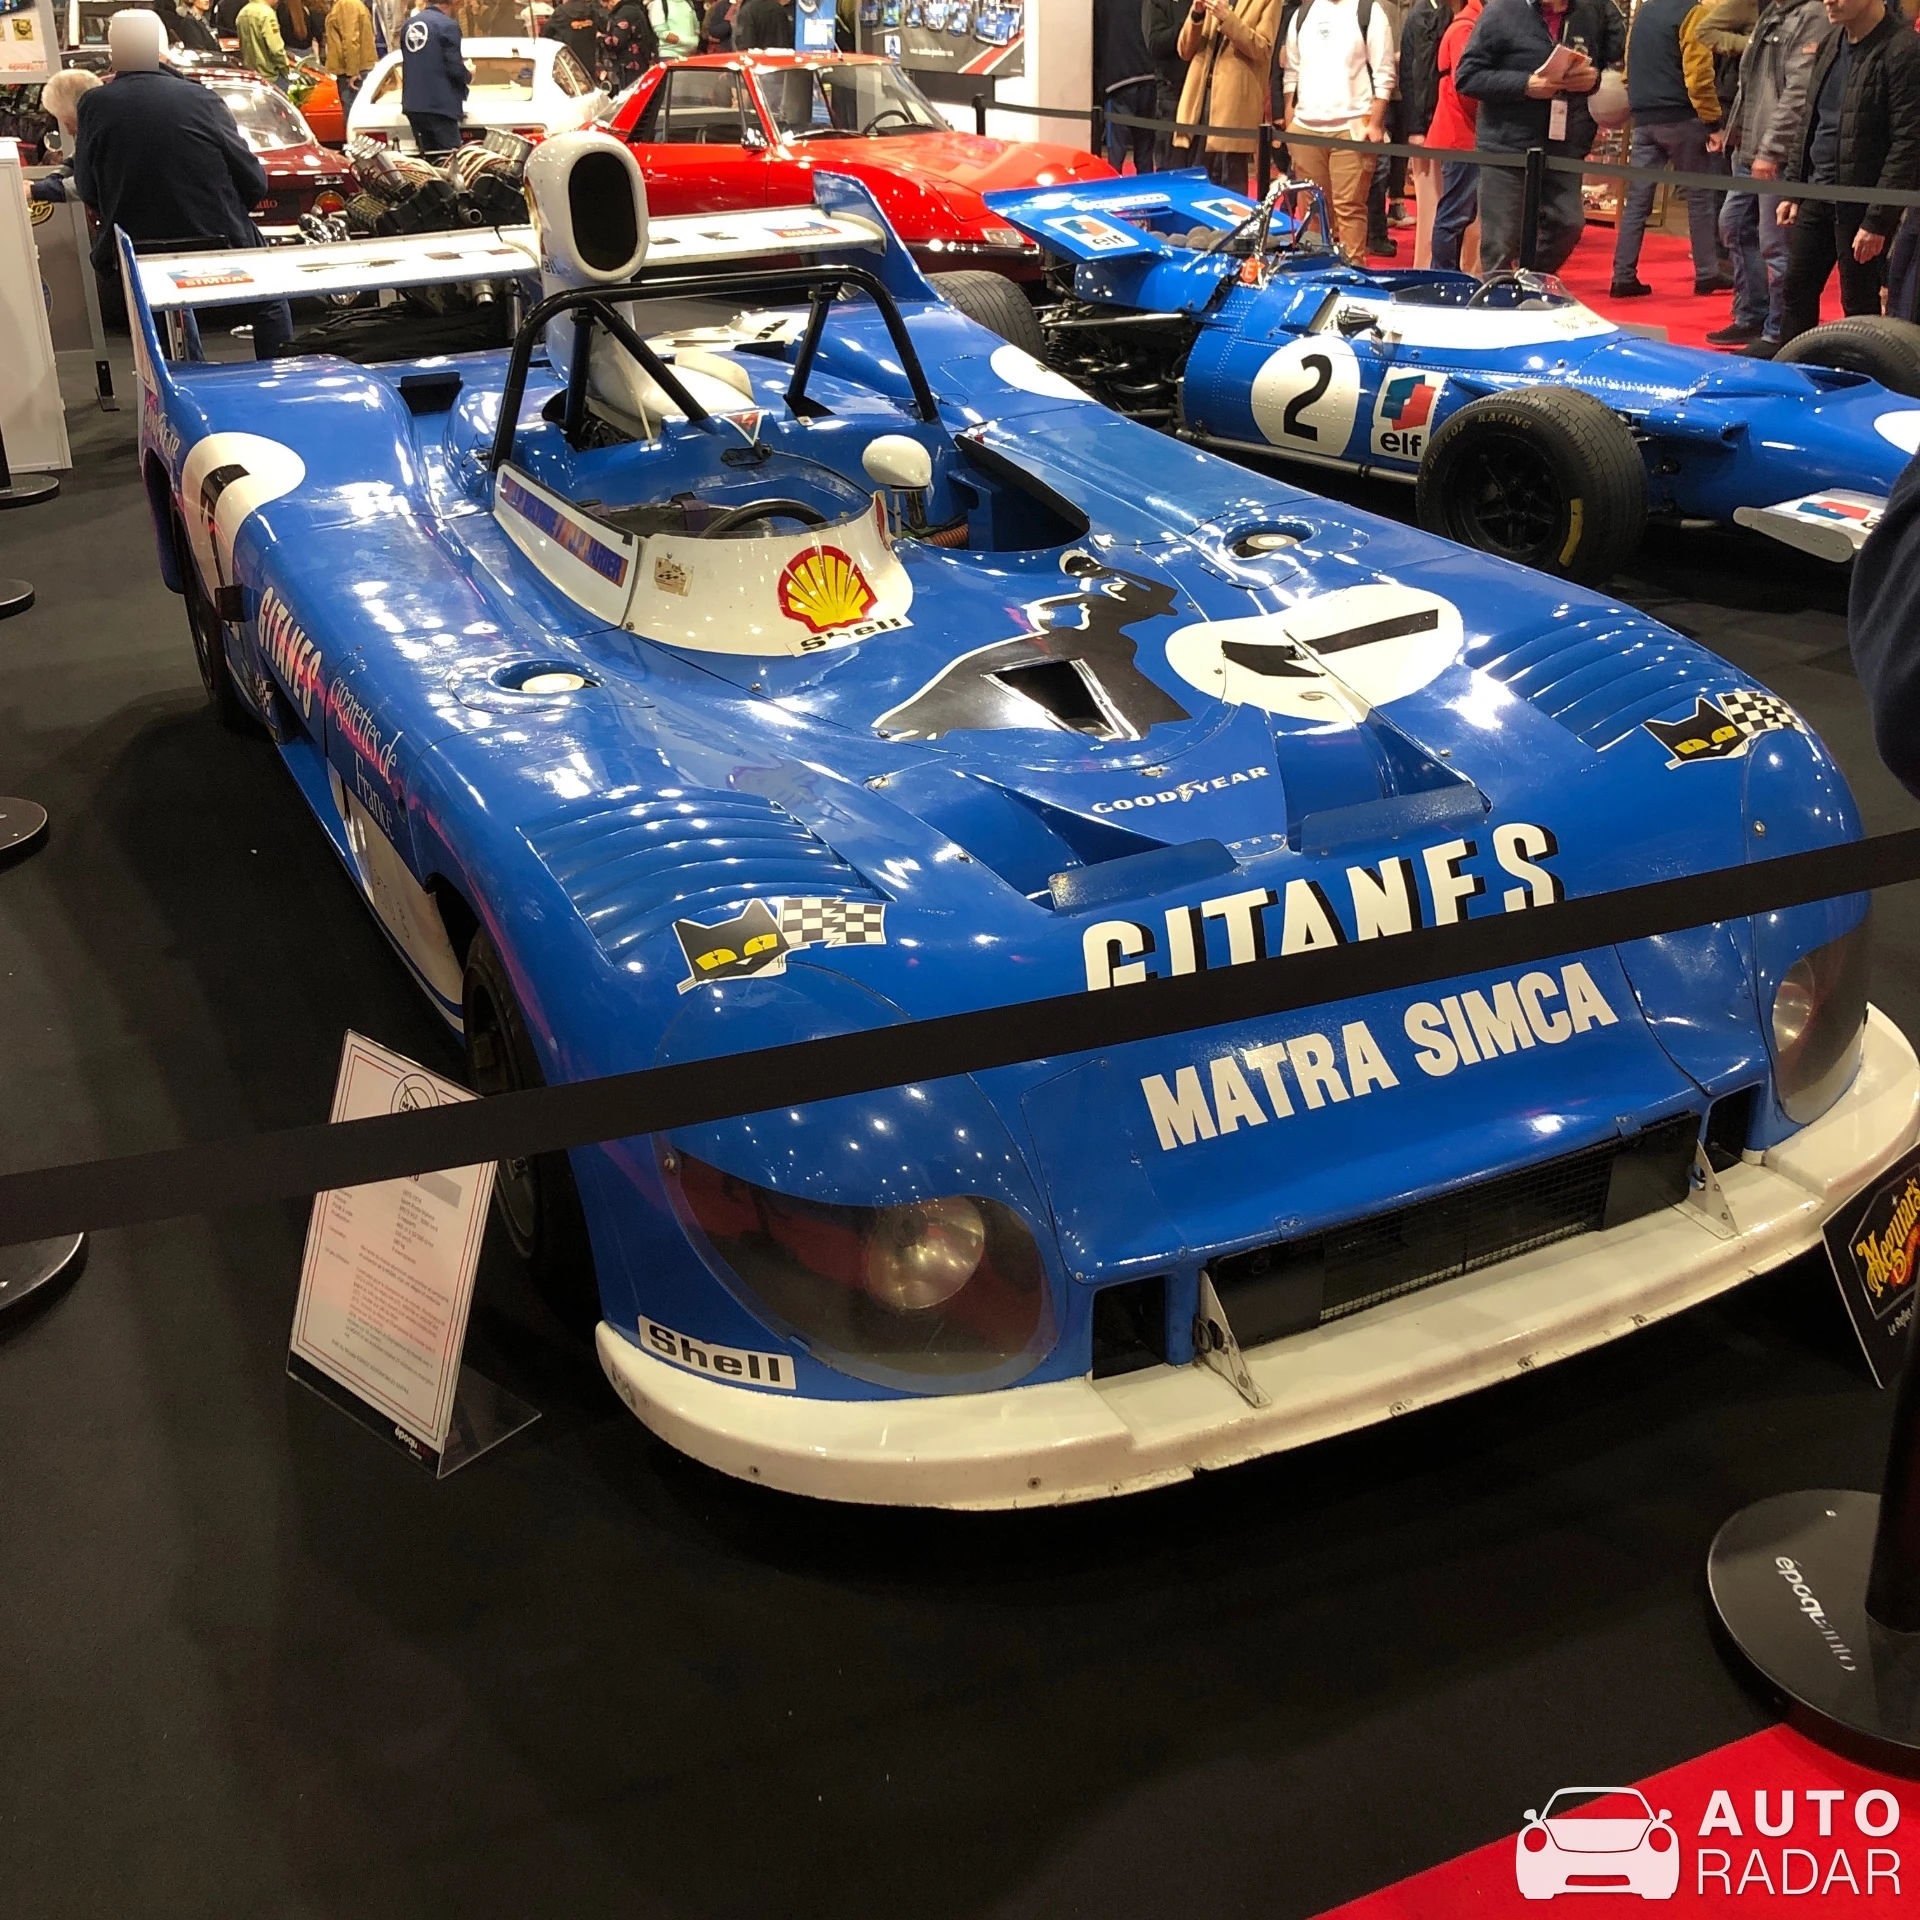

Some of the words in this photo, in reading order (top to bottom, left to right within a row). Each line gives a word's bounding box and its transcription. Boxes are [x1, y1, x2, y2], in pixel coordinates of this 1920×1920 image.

[1092, 234, 1126, 247] elf
[1283, 353, 1333, 442] 2
[1478, 412, 1532, 430] RACING
[1380, 432, 1422, 457] elf
[257, 586, 322, 720] GITANES
[800, 617, 902, 652] Shell
[379, 731, 404, 785] de
[354, 750, 395, 841] France
[1091, 766, 1270, 814] GOODYEAR
[1082, 823, 1564, 992] GITANES
[1140, 1020, 1401, 1151] MATRA
[1403, 961, 1619, 1078] SIMCA
[649, 1324, 781, 1383] Shell
